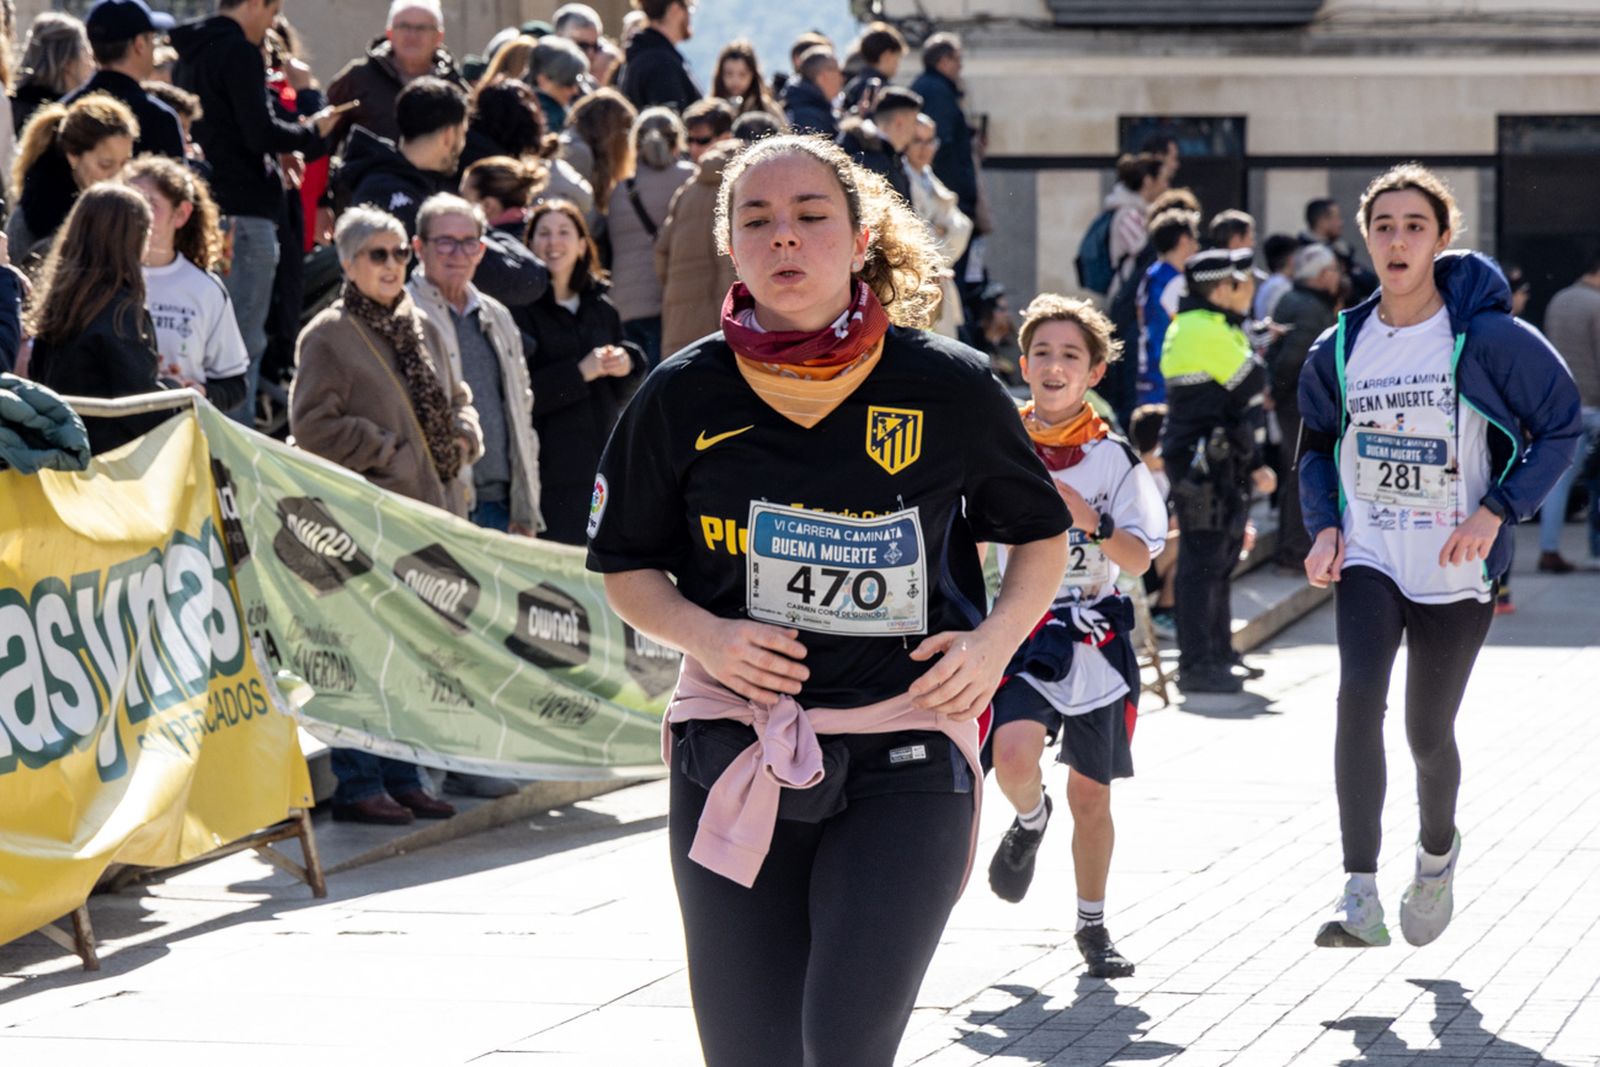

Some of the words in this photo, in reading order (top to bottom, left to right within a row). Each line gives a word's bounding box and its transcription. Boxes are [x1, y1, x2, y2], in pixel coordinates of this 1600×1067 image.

[1356, 376, 1401, 391] CARRERA
[1404, 373, 1453, 385] CAMINAT
[1386, 390, 1434, 408] MUERTE
[1366, 444, 1389, 457] BUENA
[1390, 448, 1421, 461] MUERTE
[1378, 461, 1421, 490] 281
[774, 519, 785, 532] VI
[787, 521, 841, 540] CARRERA
[844, 526, 903, 542] CAMINATA
[771, 536, 816, 559] BUENA
[820, 543, 877, 564] MUERTE
[404, 568, 468, 613] ownat
[786, 564, 887, 611] 470
[786, 602, 817, 614] CARMEN
[528, 605, 580, 645] ownat
